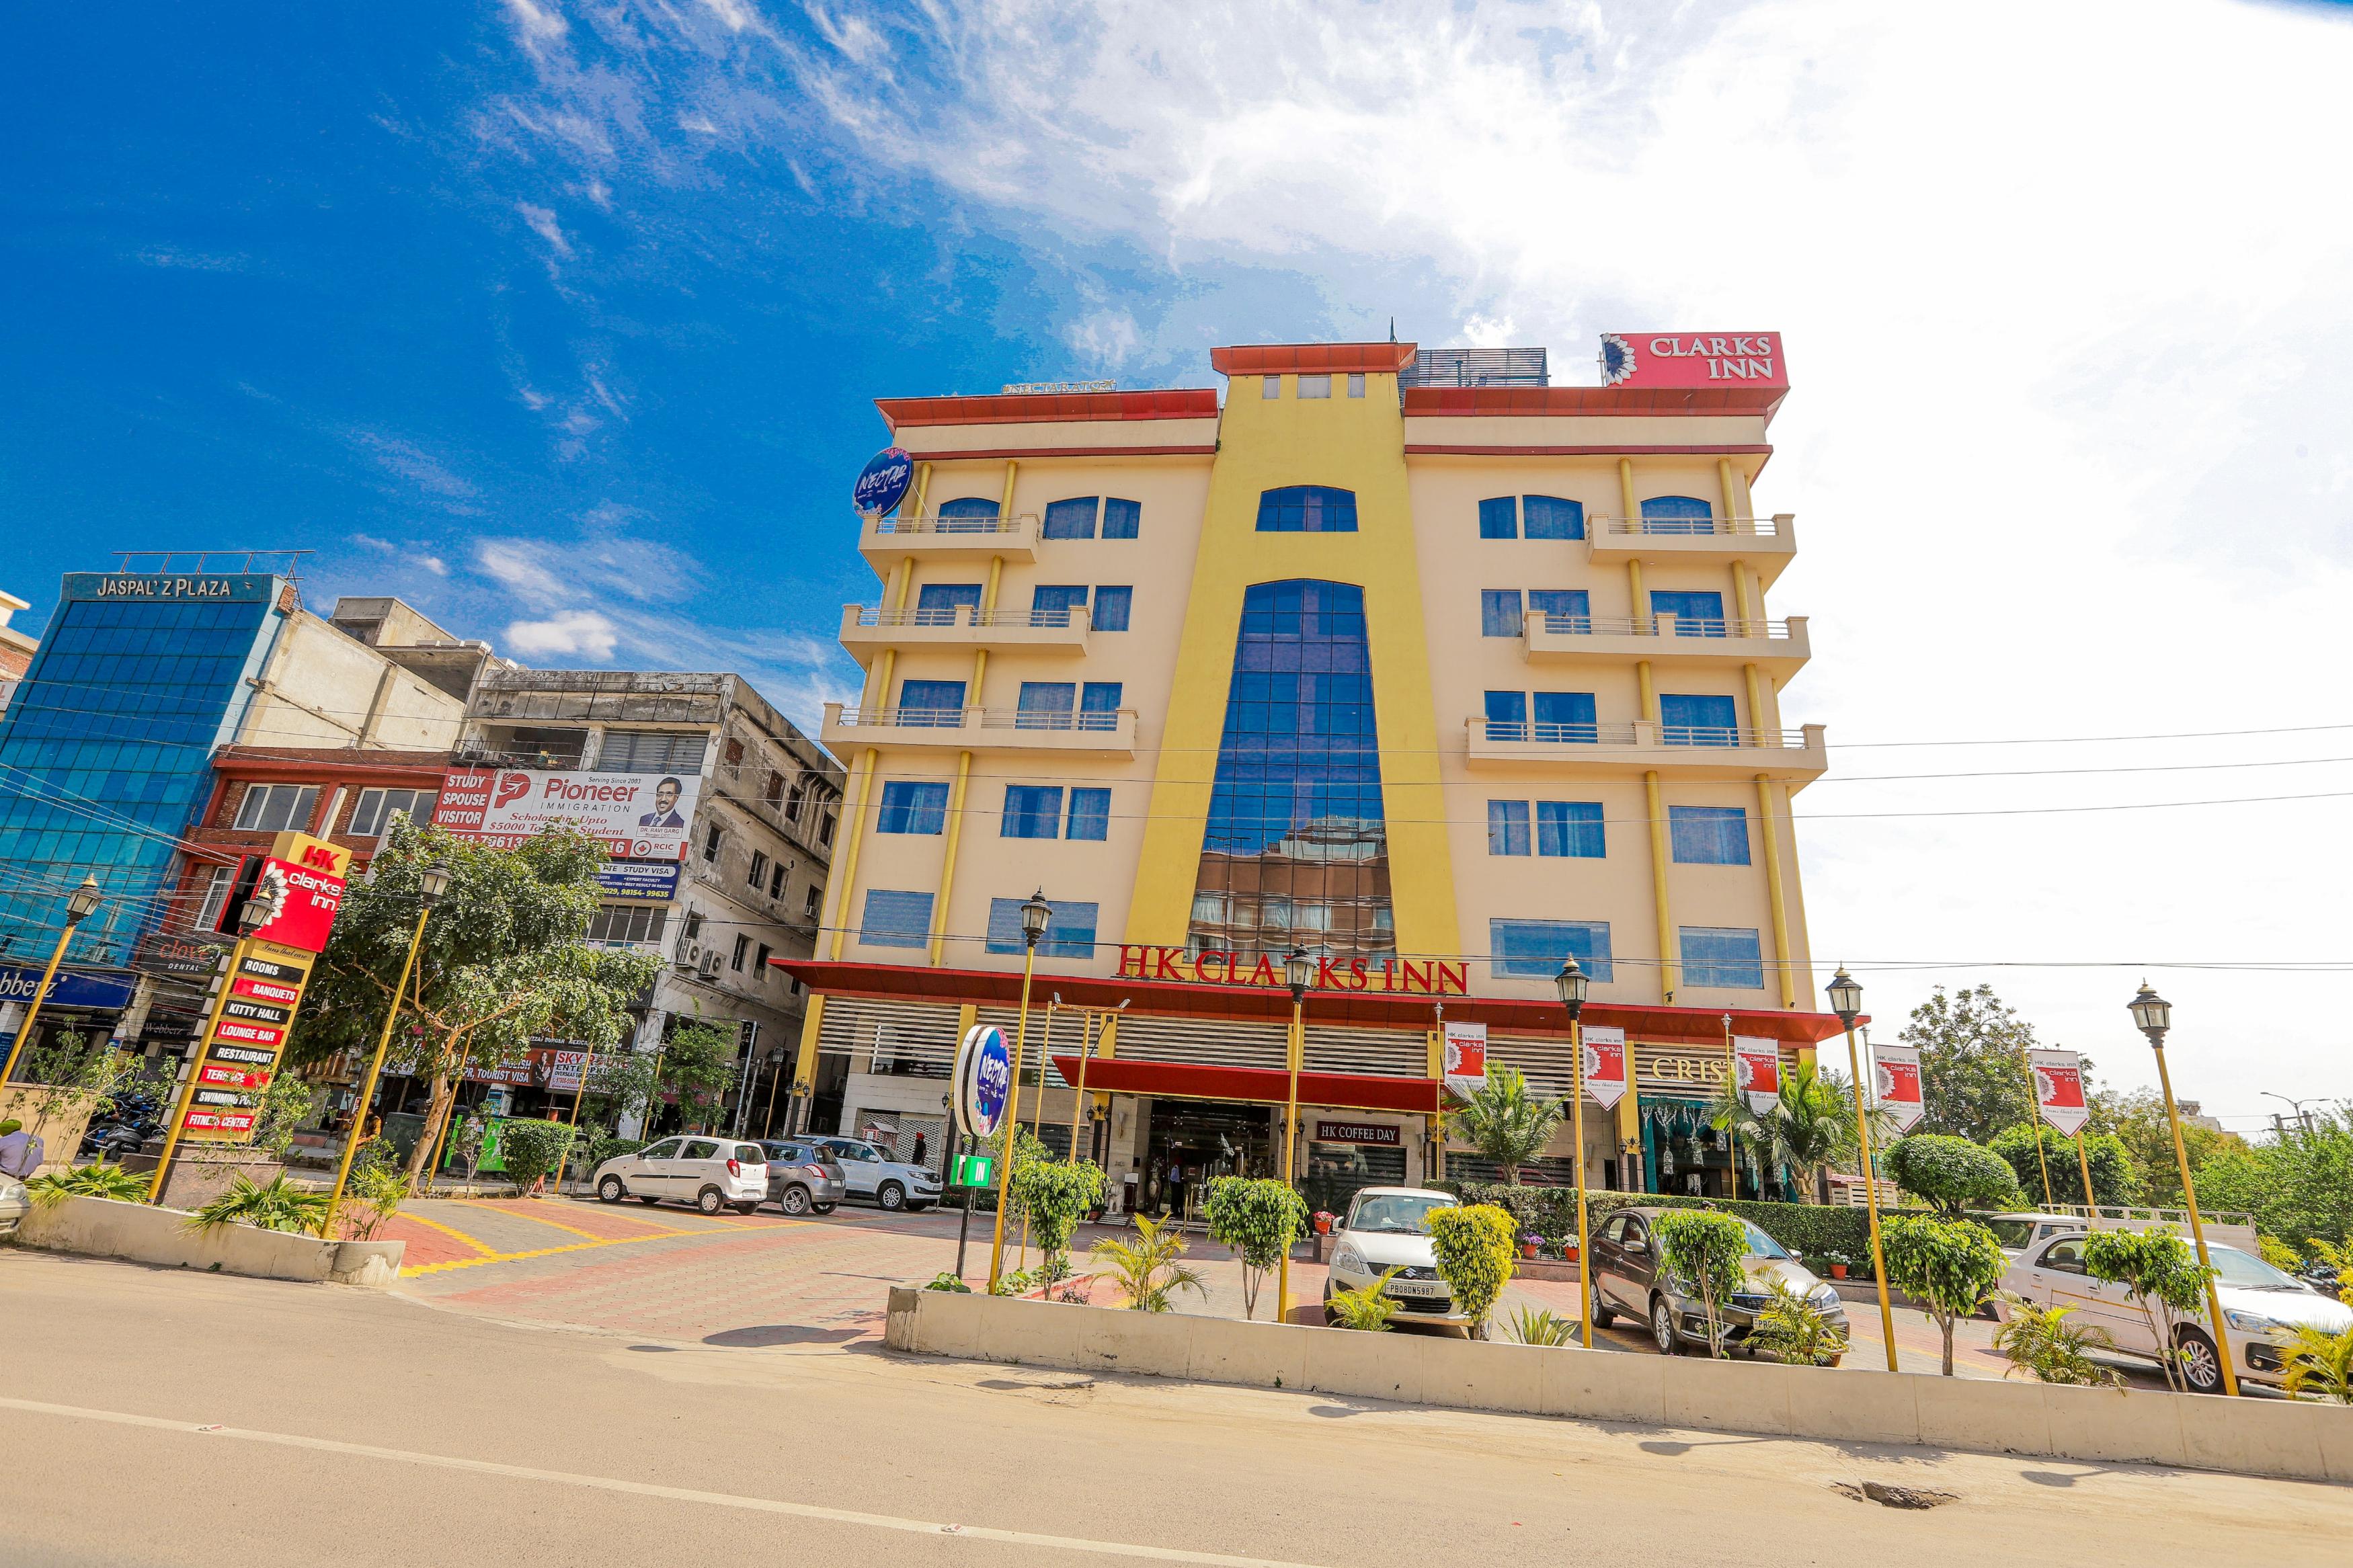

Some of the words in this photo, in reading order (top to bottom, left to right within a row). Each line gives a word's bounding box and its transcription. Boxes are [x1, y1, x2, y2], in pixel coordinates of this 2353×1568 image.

[1650, 337, 1771, 357] CLARKS
[1707, 358, 1773, 379] INN
[858, 464, 907, 493] NECTAR
[161, 581, 172, 596] Z
[175, 578, 231, 597] PLAZA
[448, 775, 486, 788] STUDY
[588, 776, 610, 784] Serving
[543, 778, 639, 802] Pioneer
[442, 792, 487, 807] SPOUSE
[541, 802, 631, 813] IMMIGRATION
[438, 810, 482, 825] VISITOR
[580, 815, 608, 825] Upto
[489, 822, 526, 831] $5000
[579, 825, 625, 835] Student
[303, 845, 341, 872] HK
[288, 872, 342, 897] clarks
[311, 892, 336, 911] inn
[159, 940, 208, 961] clove
[262, 943, 280, 953] Inns
[280, 947, 294, 956] that
[168, 962, 199, 971] DENTAL
[245, 960, 279, 976] ROOMS
[1117, 945, 1185, 981] HK
[1195, 950, 1367, 991] CLAKS
[1382, 959, 1470, 995] INN
[252, 984, 296, 1001] BANQUETS
[228, 1003, 257, 1016] KITTY
[257, 1009, 280, 1021] HALL
[145, 1022, 183, 1035] Webberz
[221, 1025, 257, 1039] LOUNGE
[257, 1030, 276, 1041] BAR
[216, 1047, 274, 1063] RESTAURANT
[558, 1053, 583, 1065] SKY
[477, 1068, 510, 1081] TOURIST
[512, 1071, 529, 1083] VISA
[980, 1053, 1008, 1089] NECTAR
[198, 1091, 238, 1104] SWIMMING
[189, 1114, 220, 1126] FITNES
[221, 1116, 250, 1128] CENTRE
[1322, 1126, 1337, 1137] HK
[1339, 1126, 1374, 1140] COFFEE
[1376, 1129, 1396, 1141] DAY
[975, 1162, 986, 1181] IN
[1390, 1284, 1435, 1296] PB08DN5987
